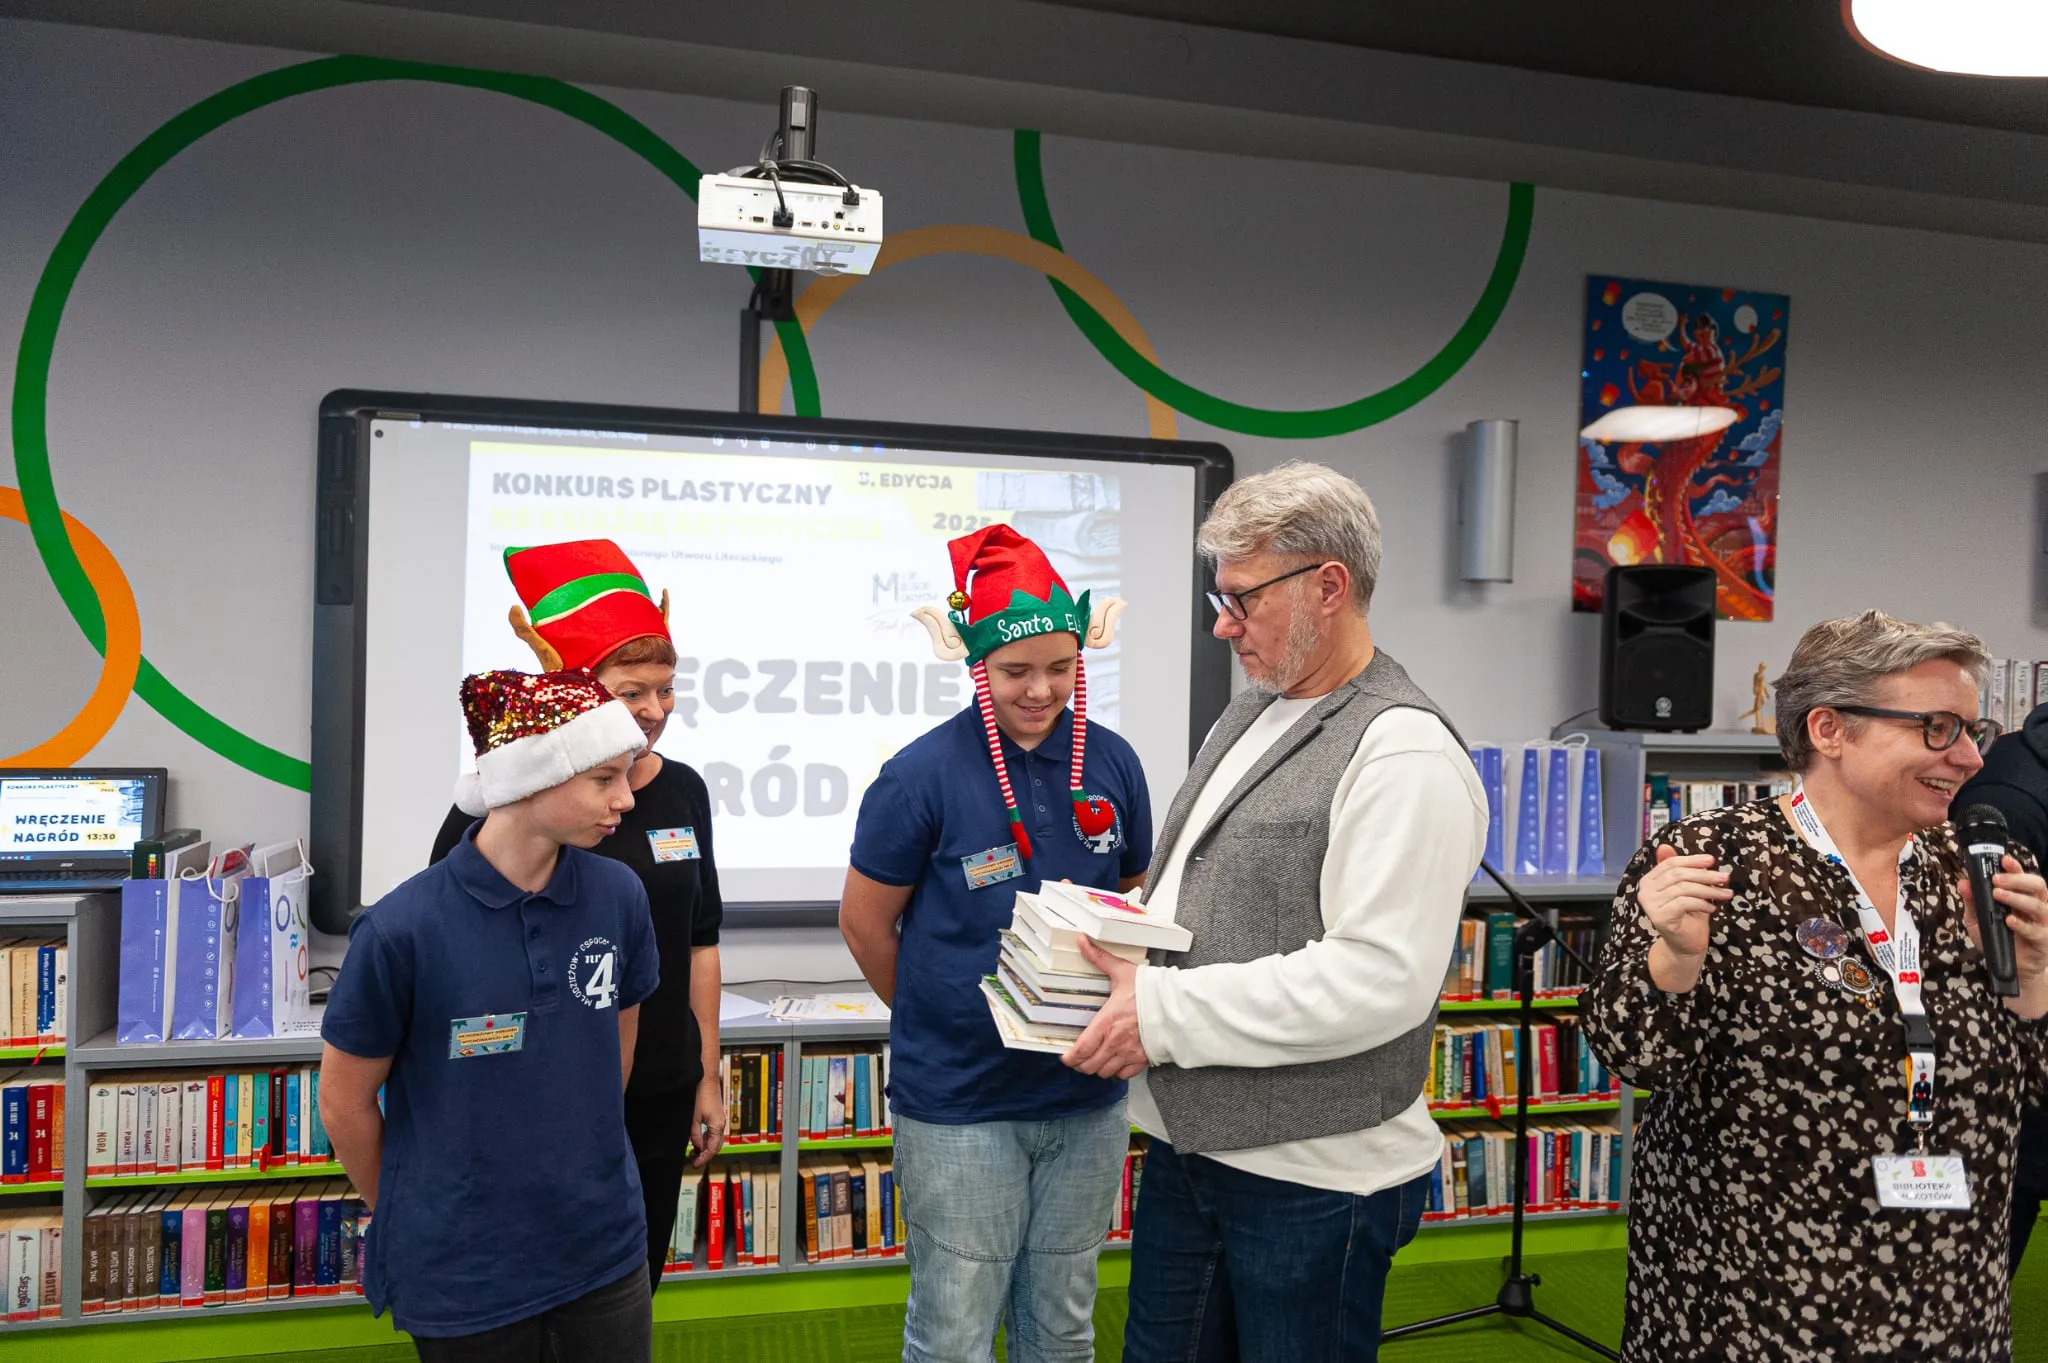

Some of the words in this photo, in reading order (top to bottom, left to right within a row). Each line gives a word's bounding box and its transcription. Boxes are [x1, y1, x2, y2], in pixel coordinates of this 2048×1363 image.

[492, 472, 635, 499] KONKURS
[641, 477, 832, 506] PLASTYCZNY
[879, 473, 953, 490] EDYCJA
[670, 550, 712, 561] Utworu
[713, 551, 783, 564] Literackiego
[998, 614, 1054, 642] Santa
[1065, 613, 1081, 634] EL
[673, 656, 963, 728] ĘCZENIE
[15, 814, 106, 828] WRĘCZENIE
[13, 829, 80, 843] NAGRÓD
[585, 952, 617, 1010] 4
[8, 1131, 19, 1141] 34
[35, 1129, 46, 1138] 34
[95, 1131, 108, 1154] NORA
